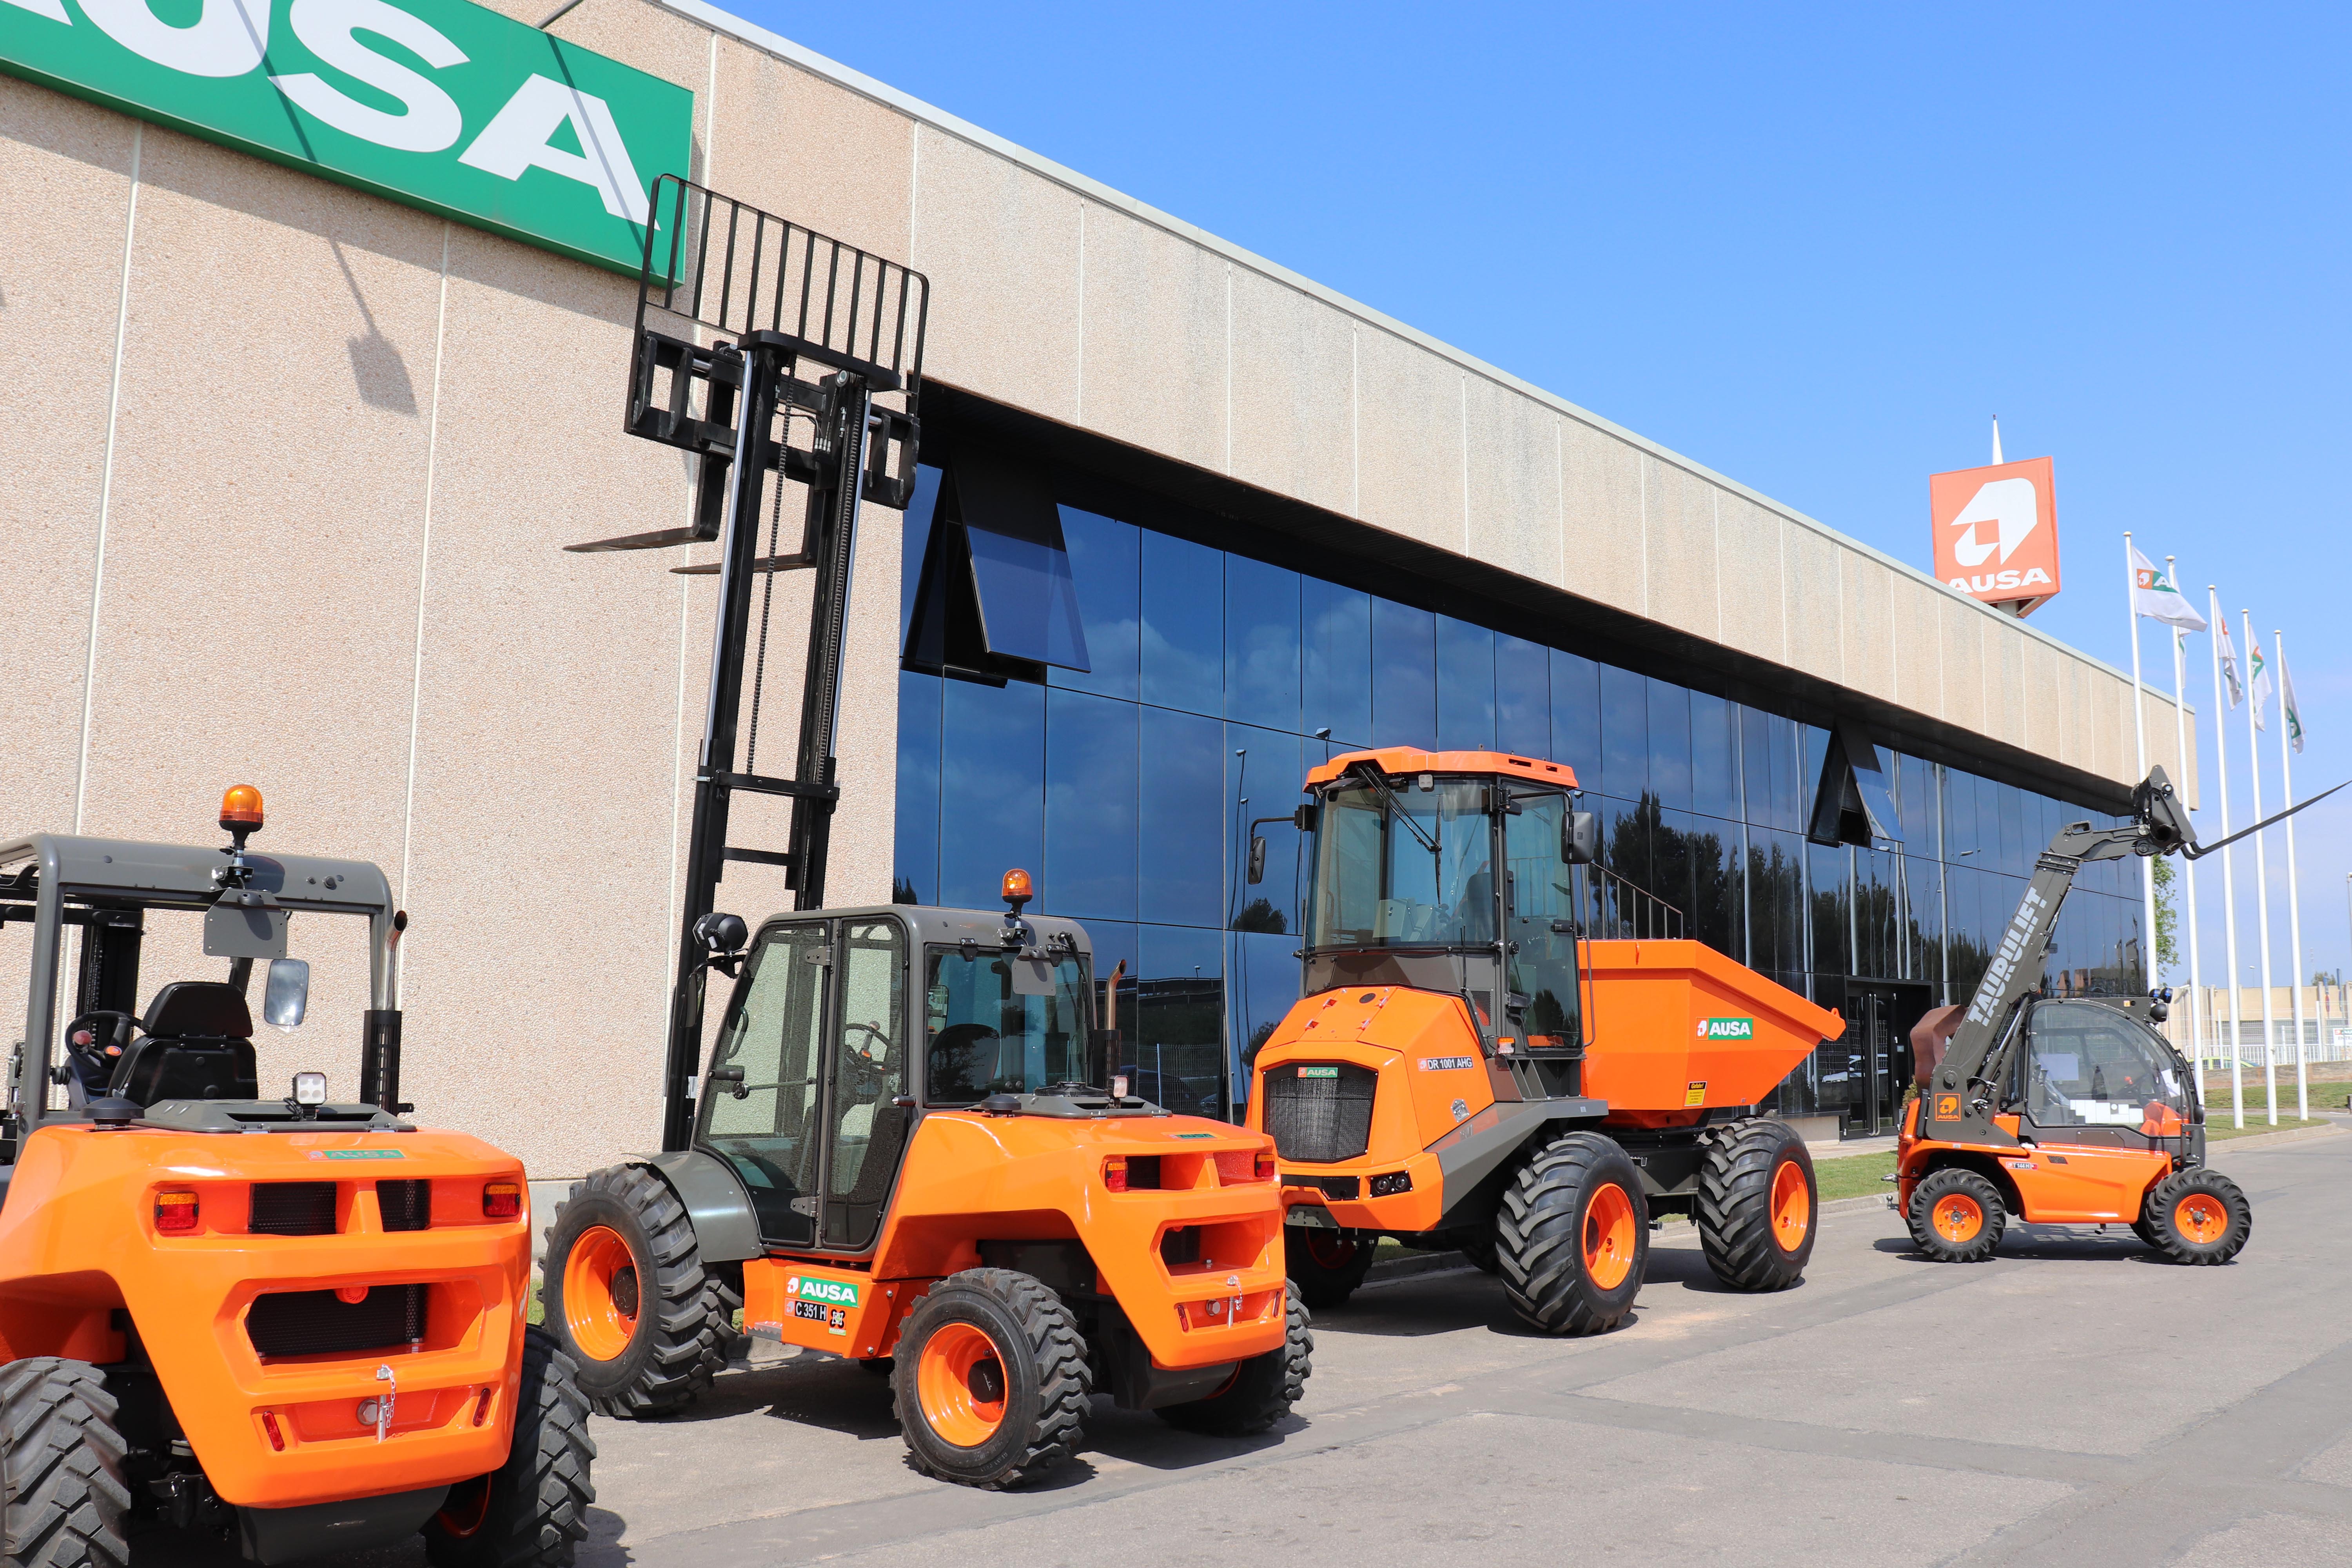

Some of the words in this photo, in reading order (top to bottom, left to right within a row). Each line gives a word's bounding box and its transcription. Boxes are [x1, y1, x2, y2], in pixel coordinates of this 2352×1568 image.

[0, 0, 660, 231] USA
[1949, 567, 2052, 593] AUSA
[1967, 886, 2047, 1027] TAURULIFT
[1709, 1021, 1751, 1036] AUSA
[1427, 1059, 1439, 1070] DR
[1440, 1058, 1455, 1069] 1001
[1457, 1058, 1472, 1068] AHG
[801, 1281, 856, 1303] AUSA
[796, 1302, 802, 1316] C
[804, 1303, 817, 1318] 351
[820, 1306, 826, 1320] H
